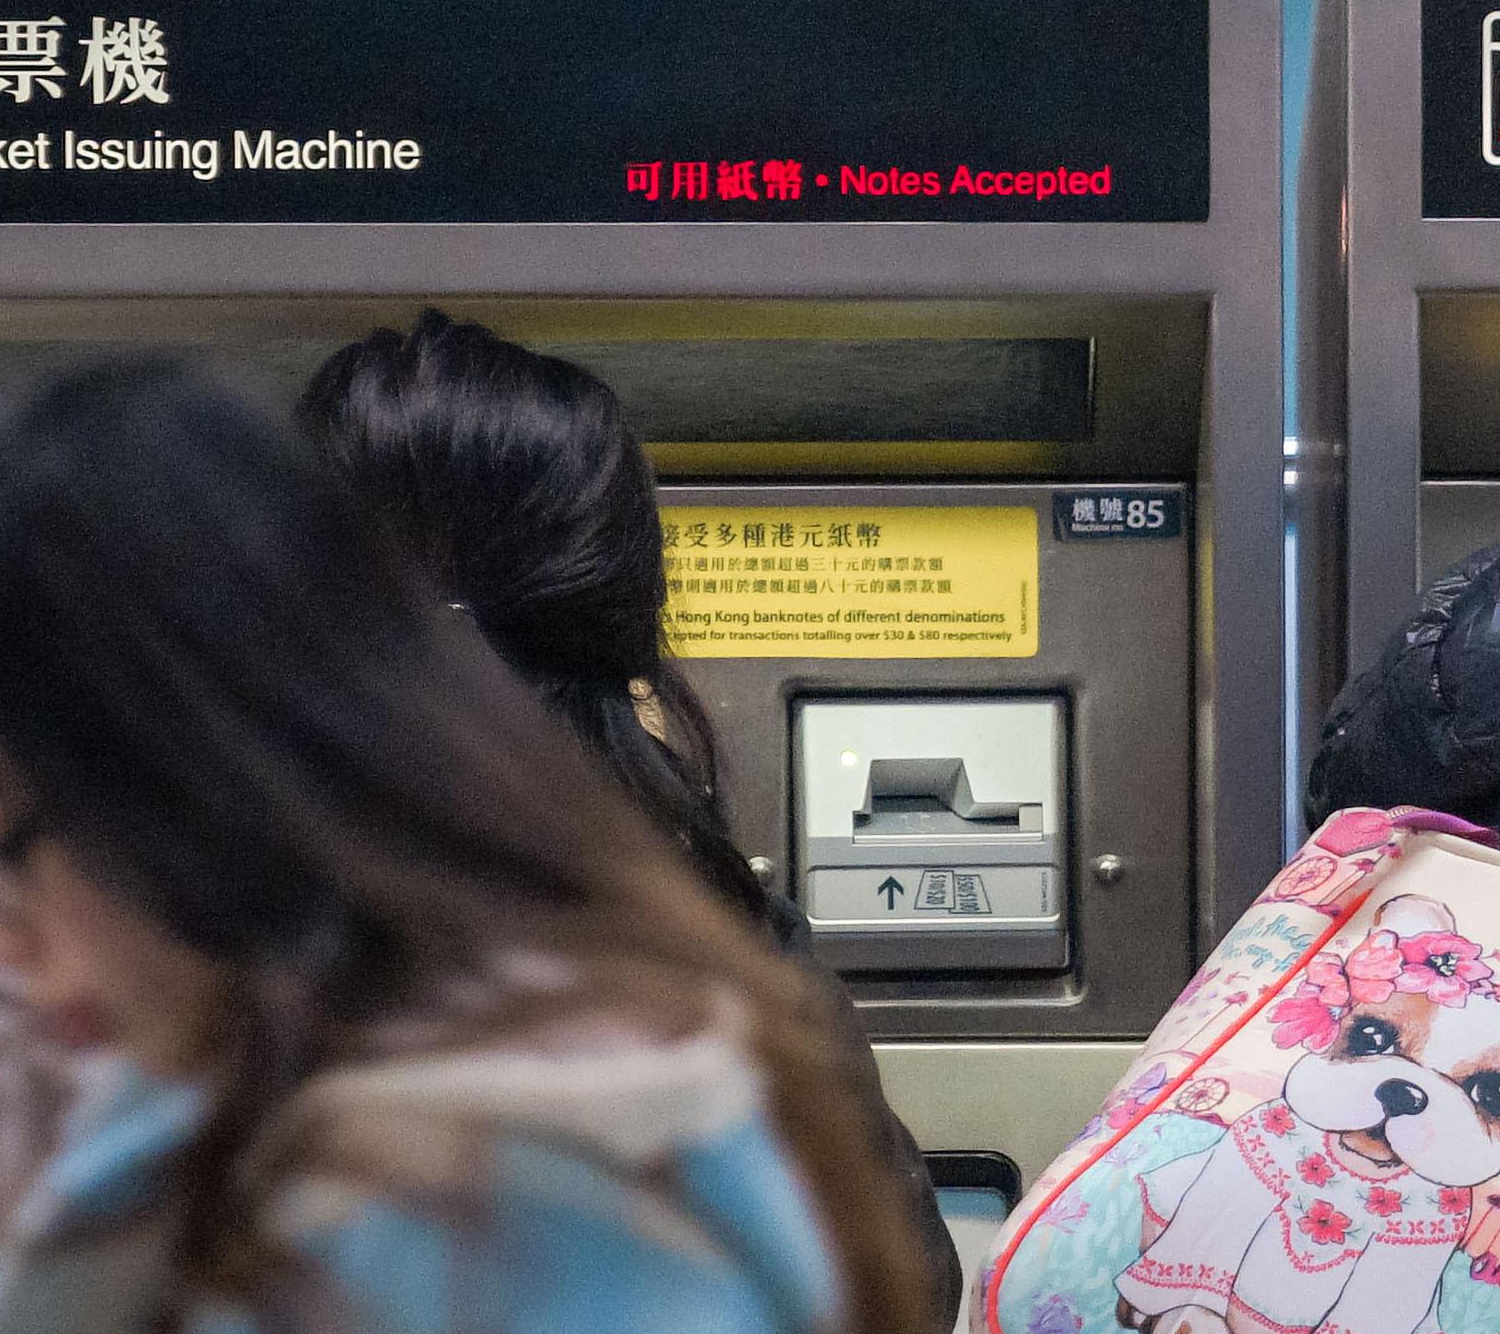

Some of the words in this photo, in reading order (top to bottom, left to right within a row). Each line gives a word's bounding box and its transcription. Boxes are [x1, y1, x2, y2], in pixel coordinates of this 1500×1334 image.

[65, 129, 218, 181] Issuing
[233, 129, 421, 171] Machine
[627, 160, 801, 201] 可用紙幣
[841, 165, 940, 196] Notes
[950, 164, 1111, 201] Accepted
[1126, 500, 1165, 529] 85
[675, 609, 712, 626] Hong
[715, 609, 750, 626] Kong
[753, 609, 824, 624] banknotes
[826, 609, 841, 624] of
[843, 609, 902, 624] different
[904, 609, 1006, 624] denominations
[710, 630, 727, 642] for
[729, 630, 800, 642] transactions
[802, 630, 853, 644] totalling
[855, 632, 881, 642] over
[943, 630, 1012, 644] respectively
